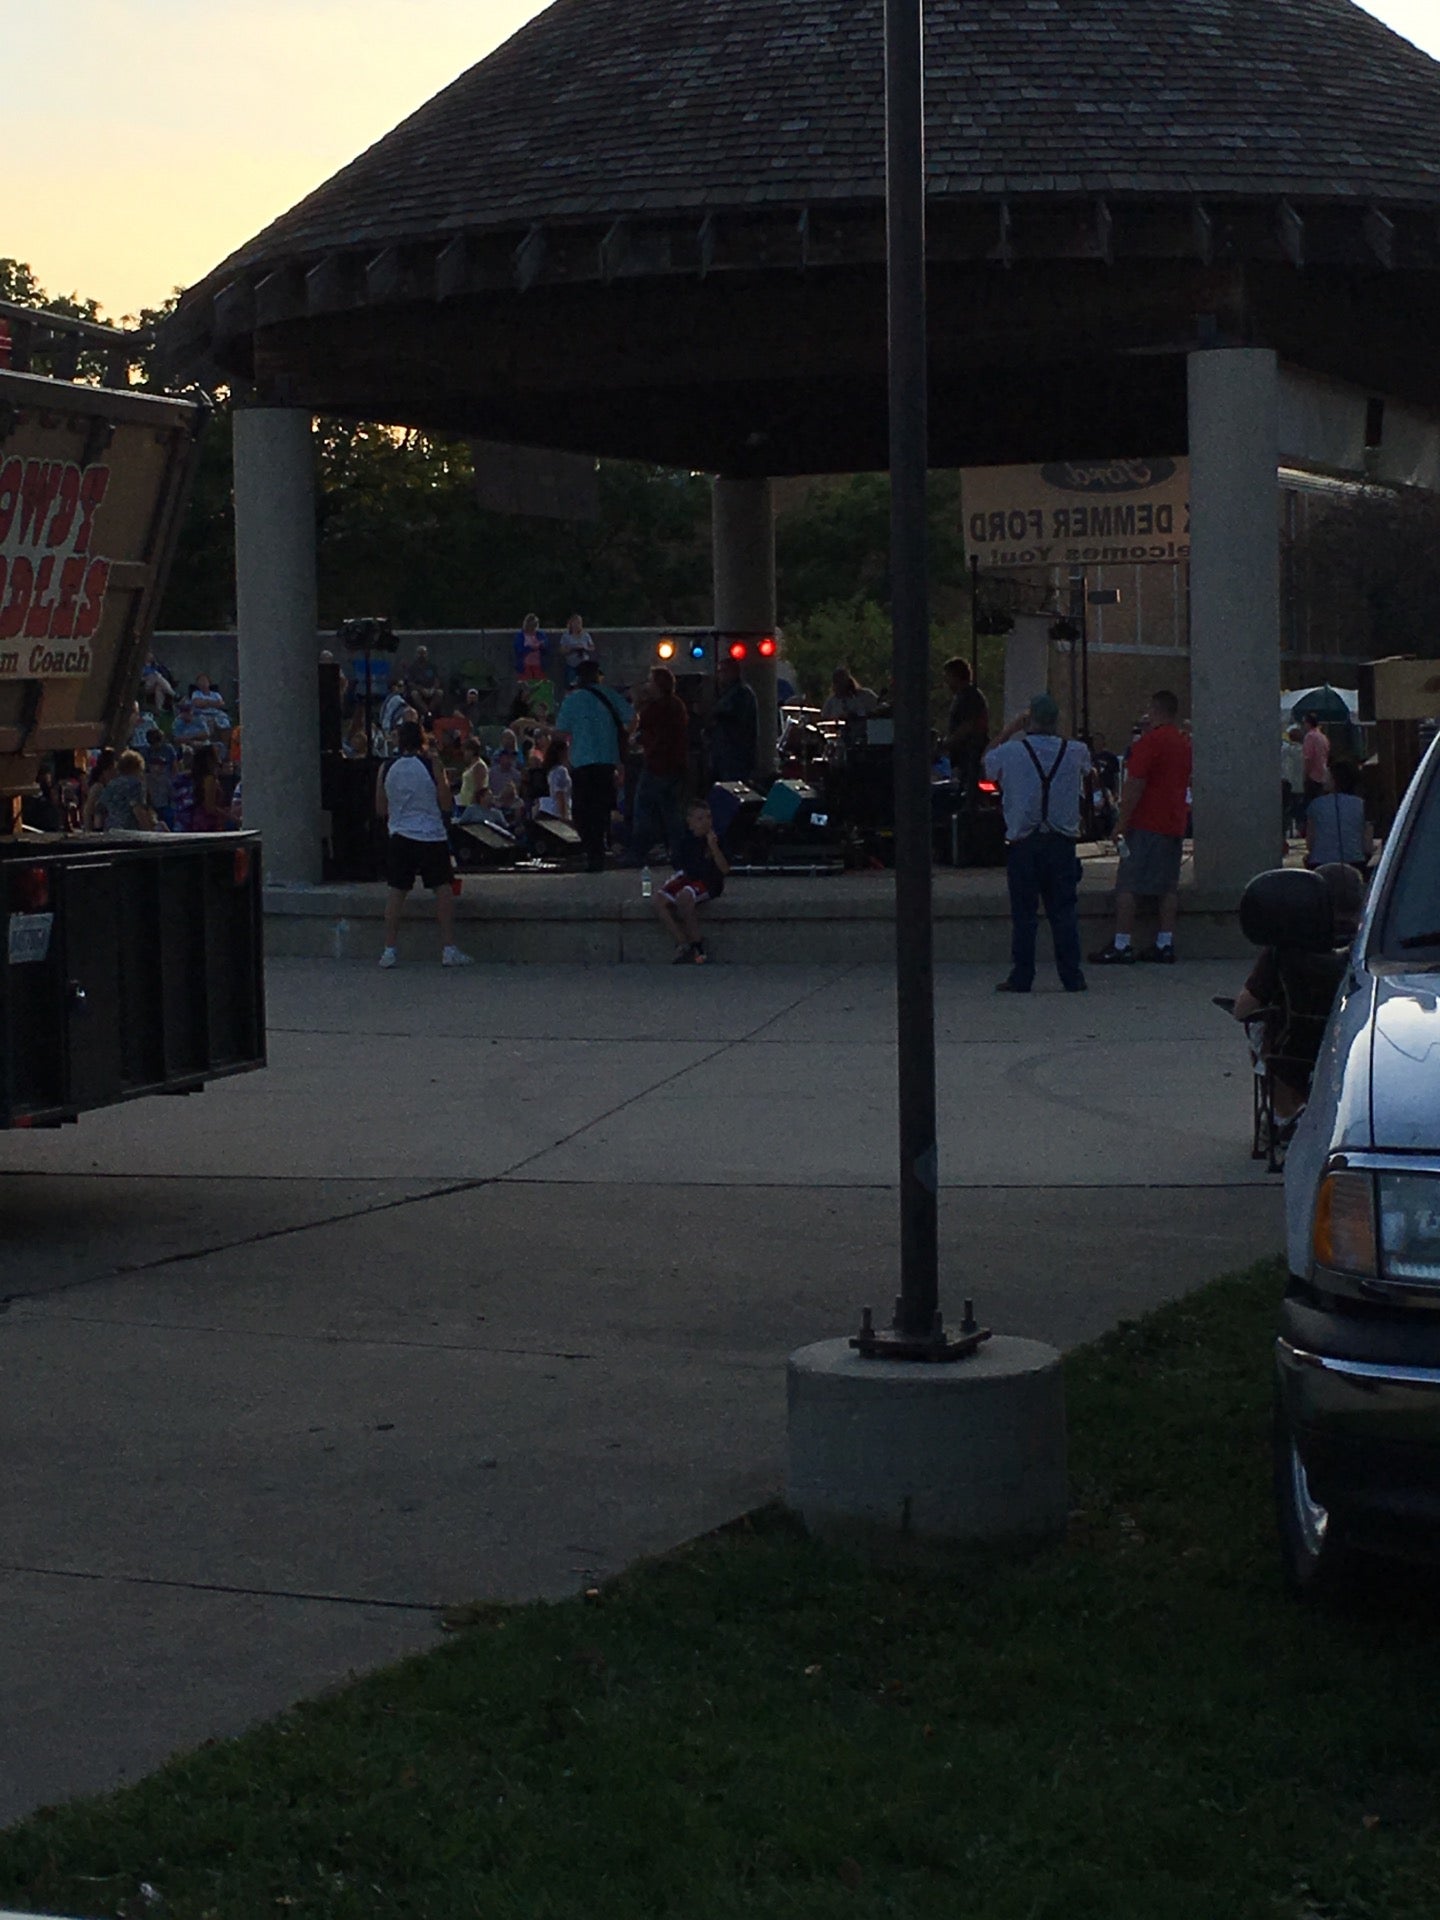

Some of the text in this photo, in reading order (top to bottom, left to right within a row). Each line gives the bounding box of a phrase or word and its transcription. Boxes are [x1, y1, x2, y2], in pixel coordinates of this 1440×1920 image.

[0, 457, 110, 553] OWDY
[0, 555, 111, 639] DLES
[29, 644, 90, 673] Coach
